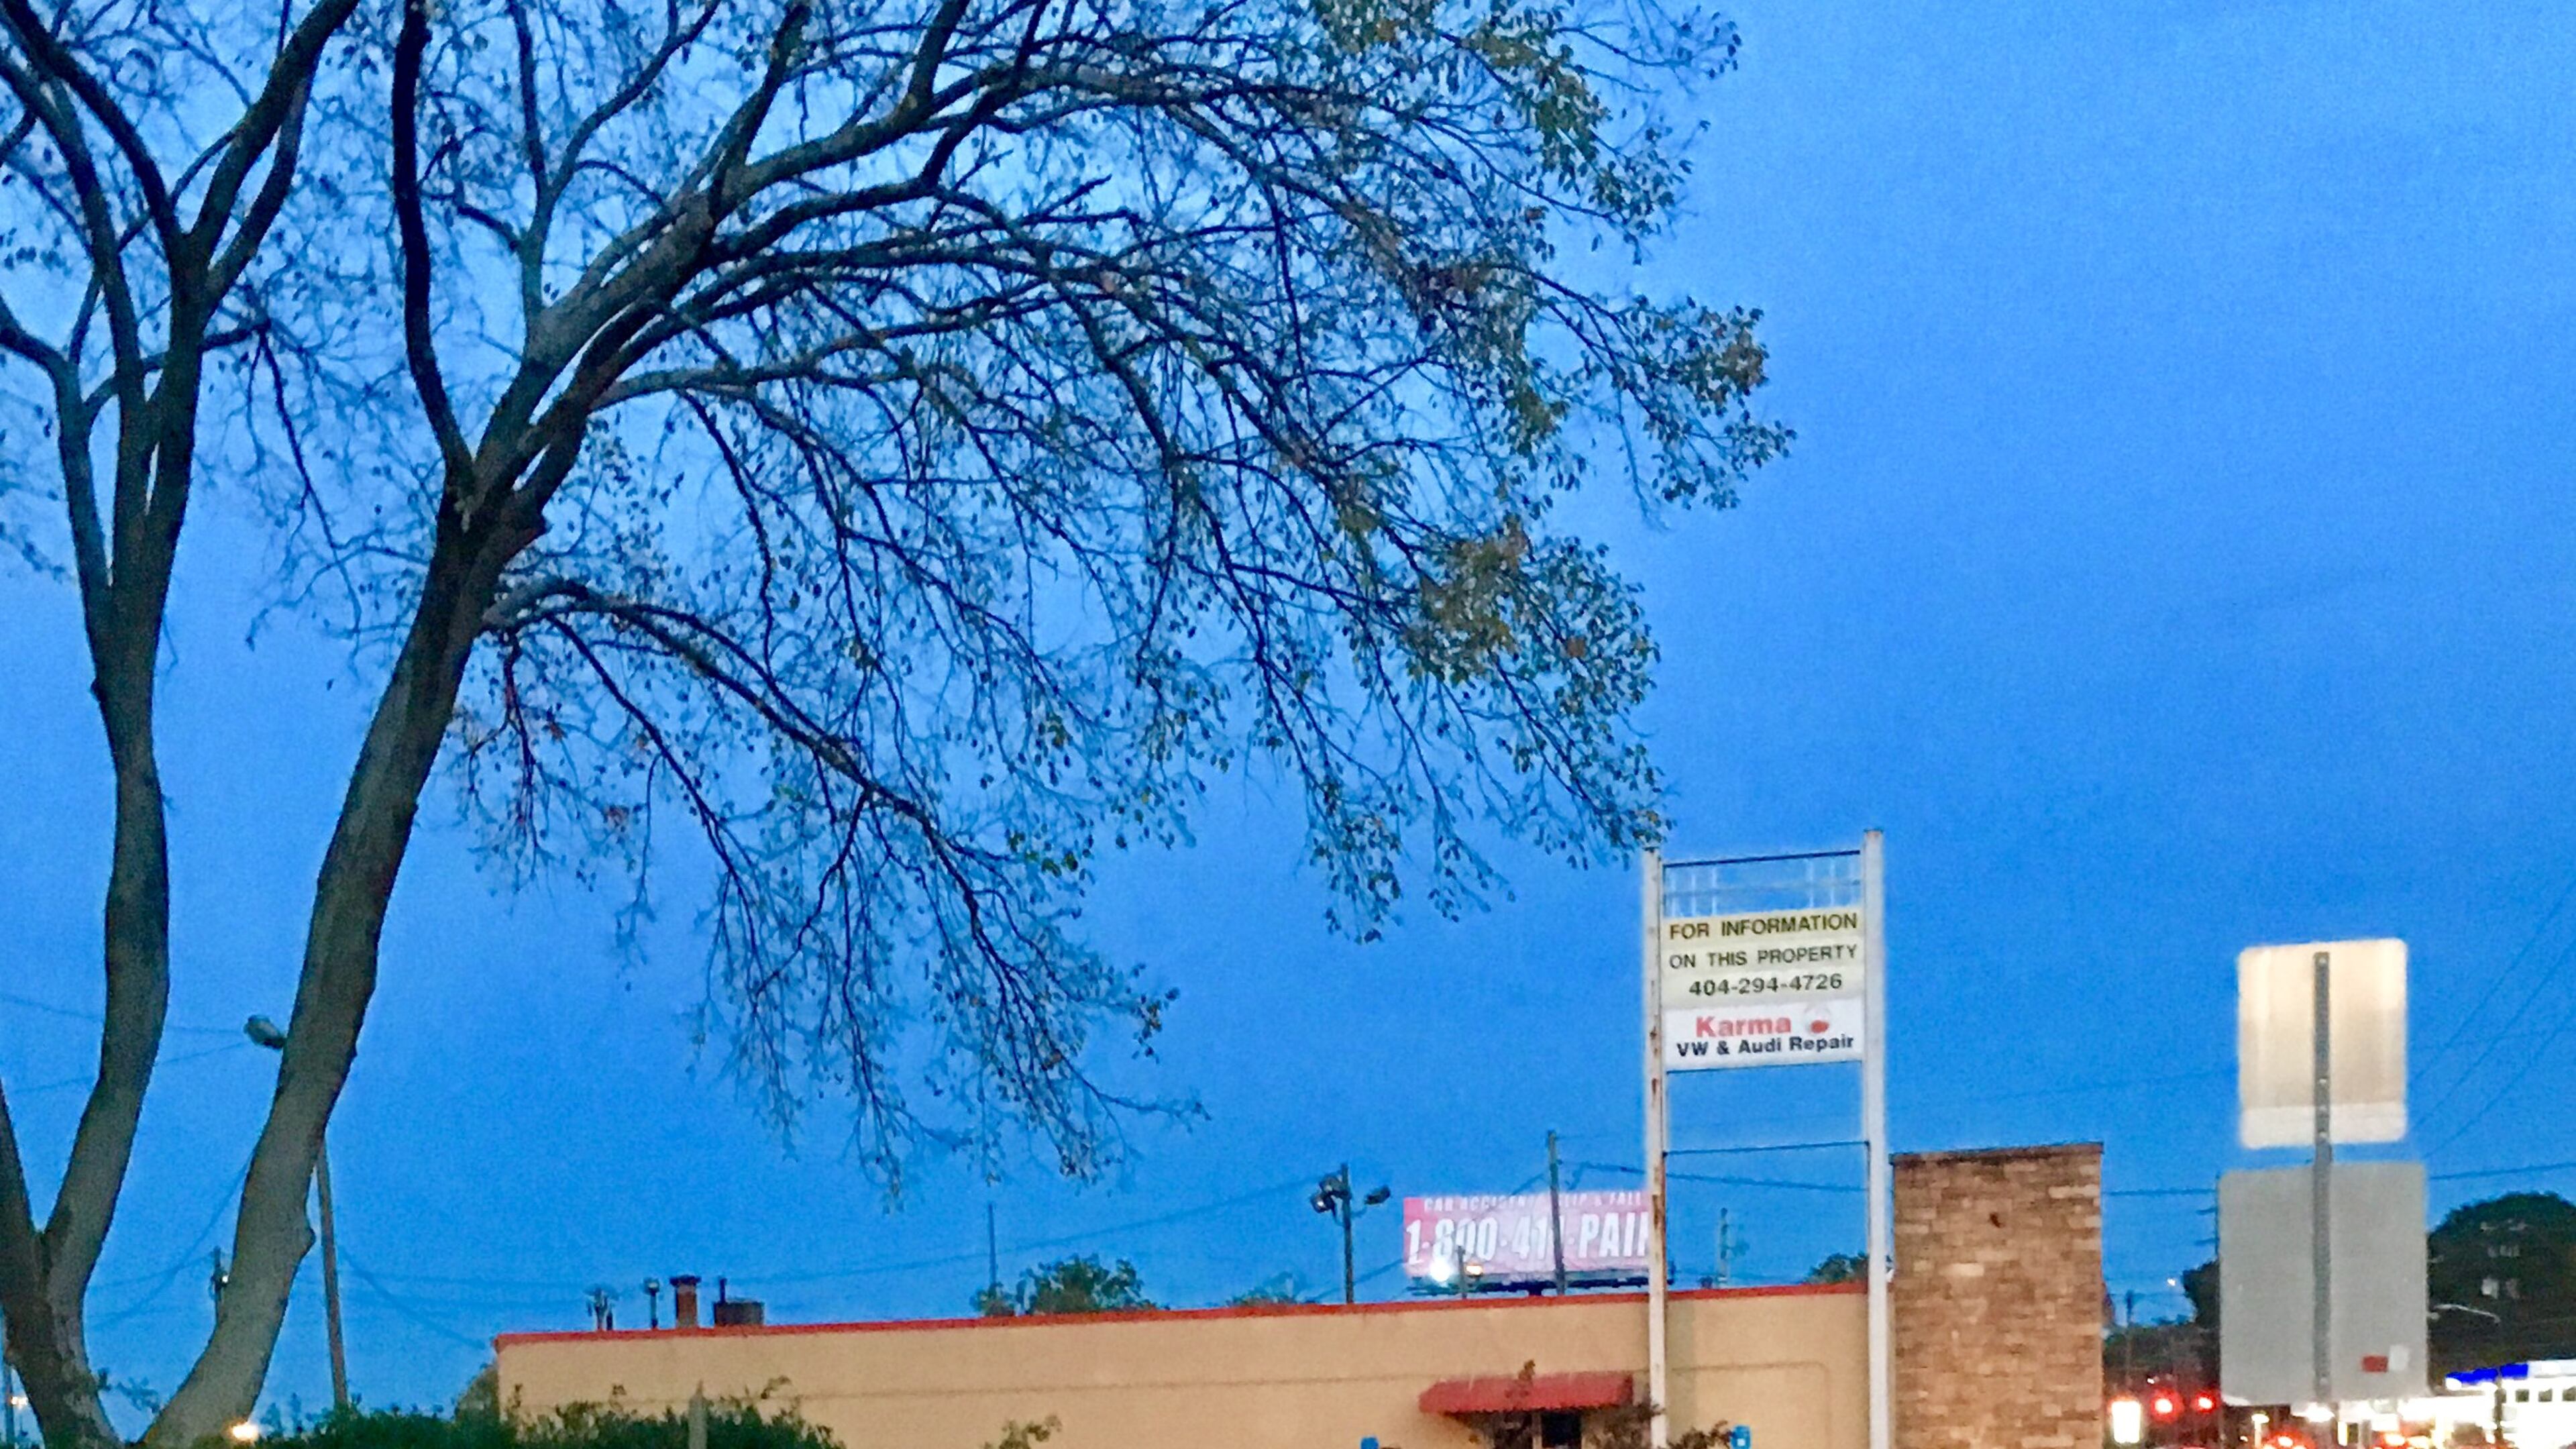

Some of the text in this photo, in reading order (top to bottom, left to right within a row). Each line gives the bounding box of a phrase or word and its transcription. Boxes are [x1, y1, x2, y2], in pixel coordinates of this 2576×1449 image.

[1670, 912, 1858, 939] FOR INFORMATION
[1669, 945, 1857, 969] ON THIS PROPERTY
[1689, 973, 1842, 996] 404-294-4726
[1696, 1016, 1792, 1038] Karma
[1676, 1034, 1854, 1057] VW & Audi Repair
[1610, 1191, 1641, 1205] FALL
